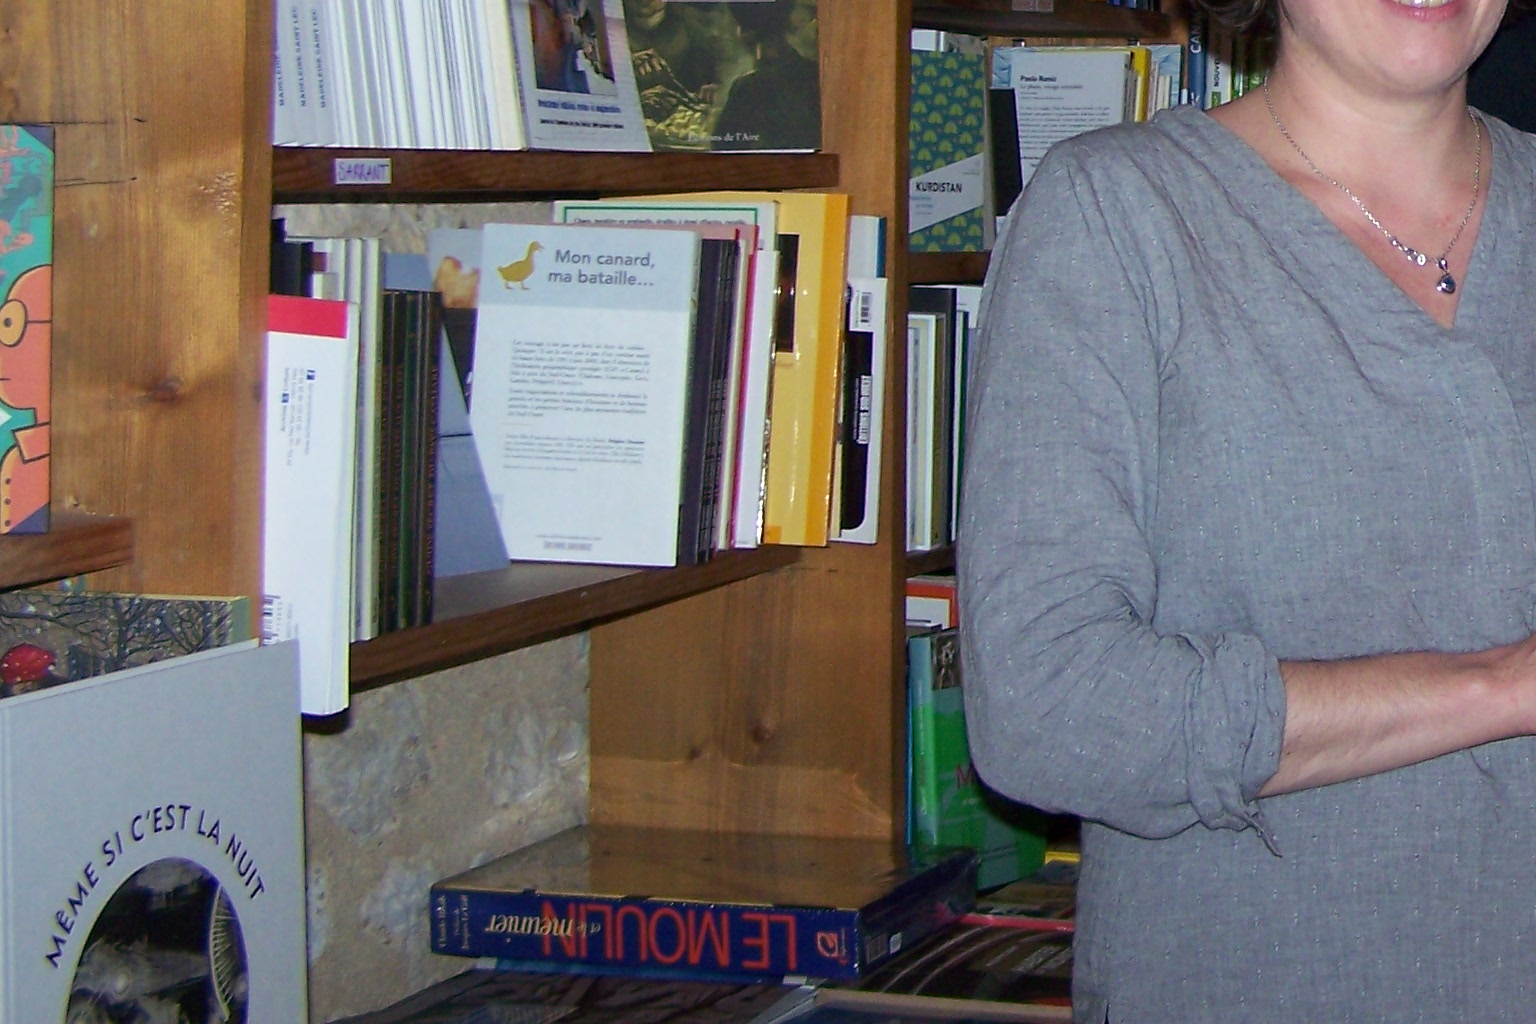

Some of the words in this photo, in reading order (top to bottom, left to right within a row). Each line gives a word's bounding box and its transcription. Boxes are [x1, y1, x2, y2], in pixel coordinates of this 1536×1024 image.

[915, 181, 962, 193] KURDISTAN
[555, 249, 591, 265] Mon
[596, 251, 655, 269] canard,
[548, 270, 572, 284] ma
[577, 269, 654, 287] bataille...
[102, 831, 125, 867] SI
[131, 803, 192, 842] C'EST
[198, 809, 221, 846] LA
[226, 833, 266, 900] NUIT
[485, 912, 573, 943] meunier
[541, 900, 730, 970] MOULIN
[742, 911, 796, 971] LE
